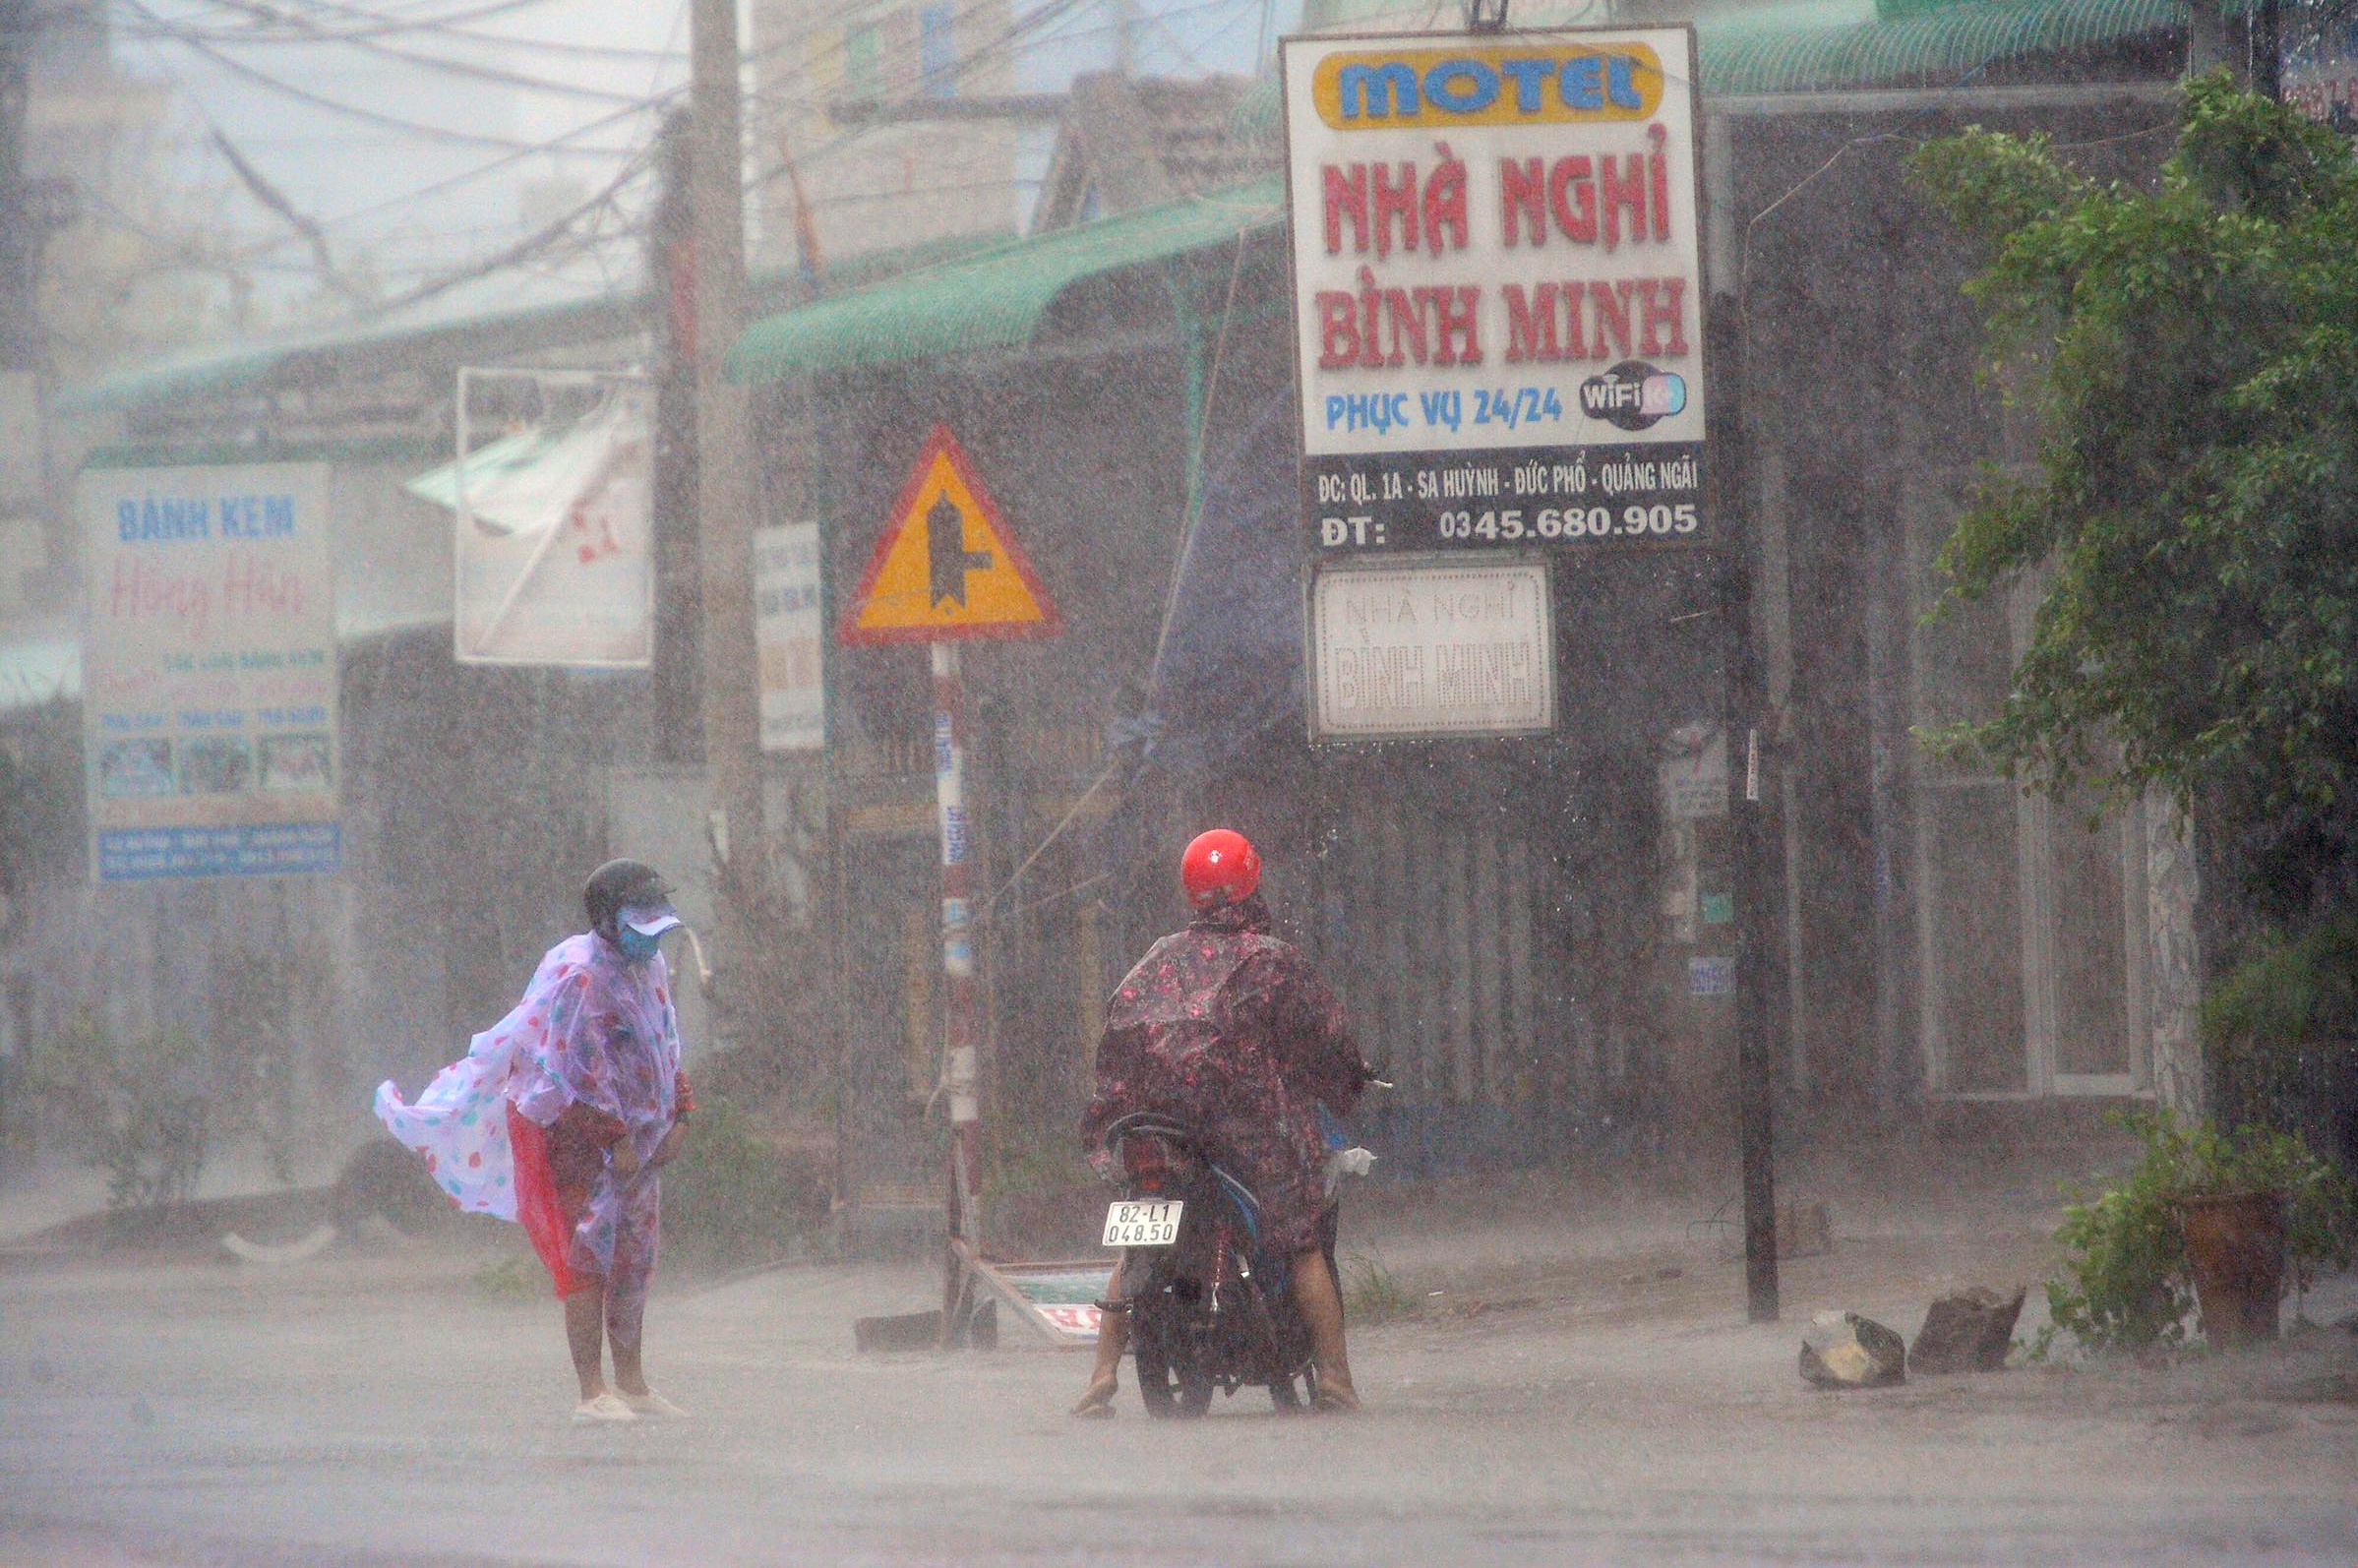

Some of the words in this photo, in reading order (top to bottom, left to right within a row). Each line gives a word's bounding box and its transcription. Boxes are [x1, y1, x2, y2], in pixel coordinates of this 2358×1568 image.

[1340, 55, 1644, 118] MOTEL
[1322, 140, 1470, 261] NHÀ
[1499, 123, 1671, 254] NGHỈ
[1314, 264, 1483, 369] BÌNH
[1500, 276, 1689, 363] MINH
[1325, 390, 1409, 436] PHỤC
[1419, 390, 1462, 433] VỤ
[1474, 386, 1562, 430] 24/24
[1318, 474, 1347, 503] ĐC:
[1350, 473, 1376, 506] QL.
[1382, 471, 1403, 500] 1A
[1418, 470, 1439, 499] SA
[1443, 461, 1499, 497] HUỲNH
[1515, 458, 1548, 494] ĐỨC
[1552, 450, 1586, 493] PHỔ
[1602, 452, 1657, 496] QUẢNG
[1660, 453, 1698, 490] NGÃI
[1321, 515, 1385, 546] ĐT:
[1439, 504, 1698, 540] 0345.680.905
[1108, 1224, 1174, 1243] 048.50
[1119, 1204, 1170, 1223] 82-L1
